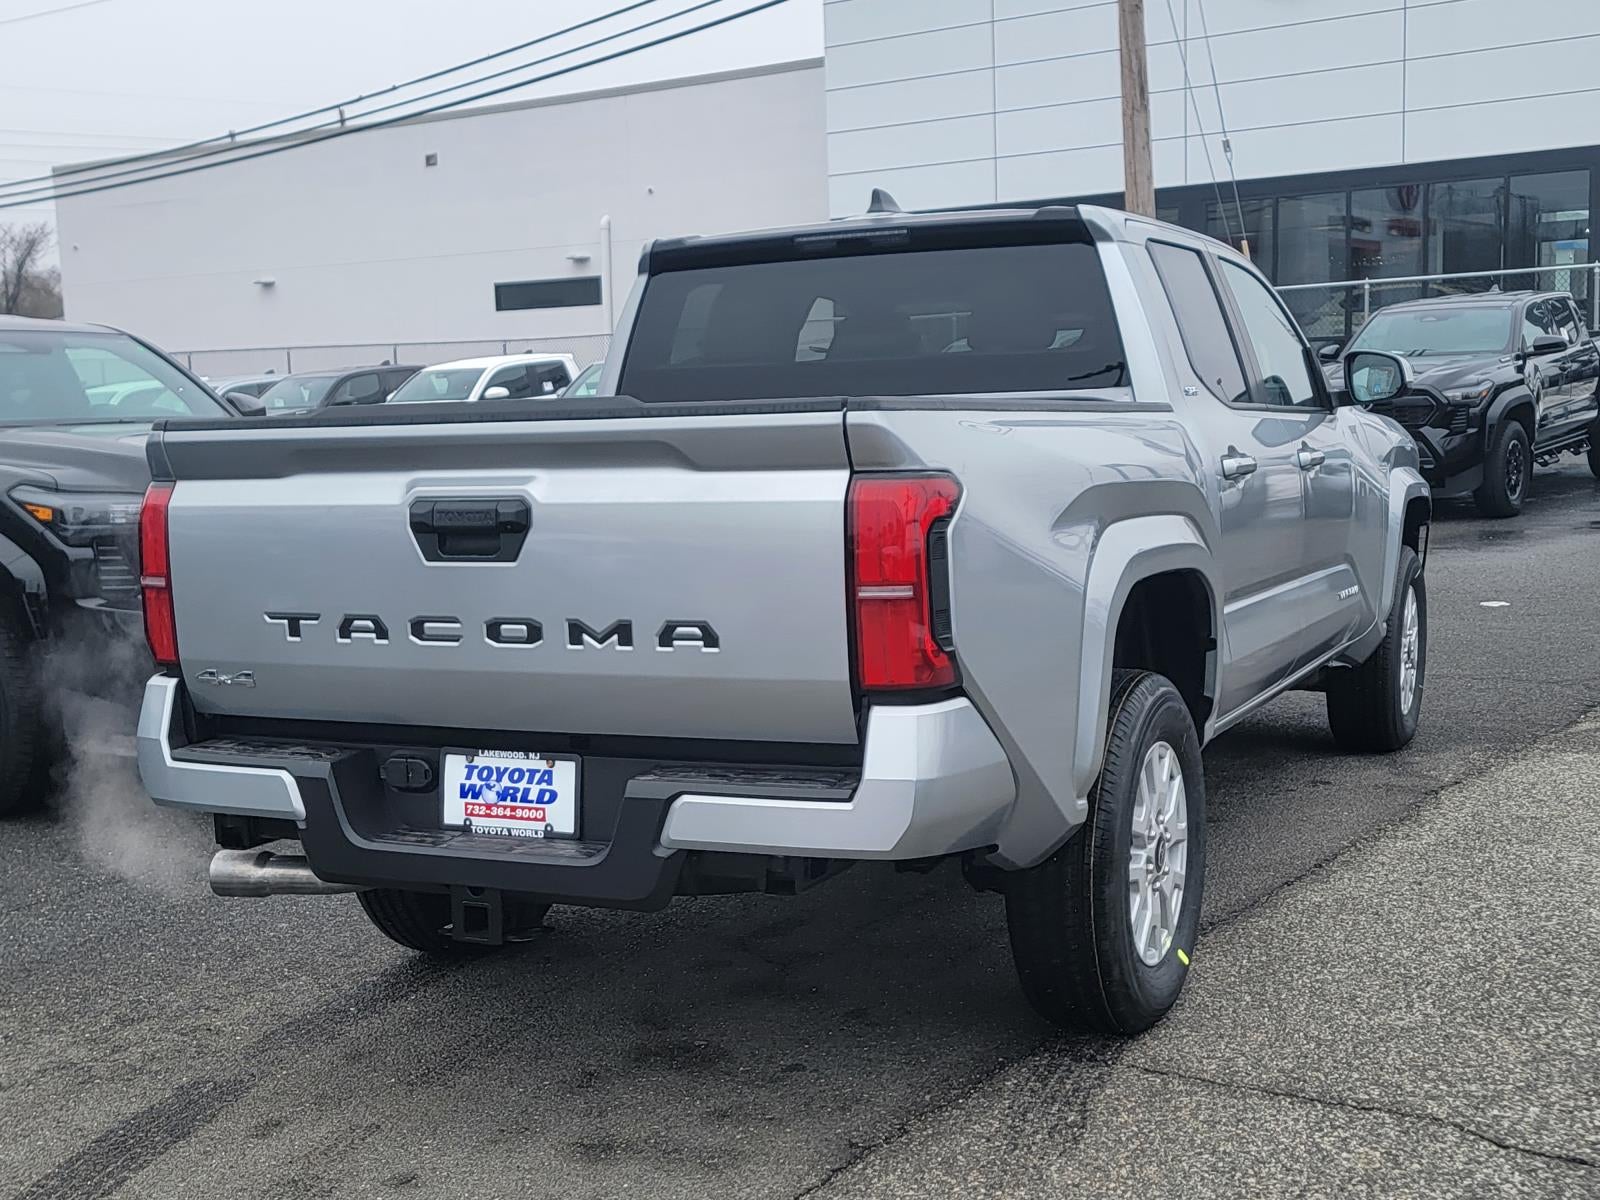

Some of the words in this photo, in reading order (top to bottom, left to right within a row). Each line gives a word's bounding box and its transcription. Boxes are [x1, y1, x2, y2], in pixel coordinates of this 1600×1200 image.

[263, 611, 720, 652] TACOMA
[529, 752, 540, 760] NJ
[464, 764, 554, 786] TOYOTA
[459, 782, 559, 805] WORLD
[466, 805, 544, 819] 732-364-9000
[471, 825, 509, 837] TOYOTA
[511, 828, 545, 838] WORLD
